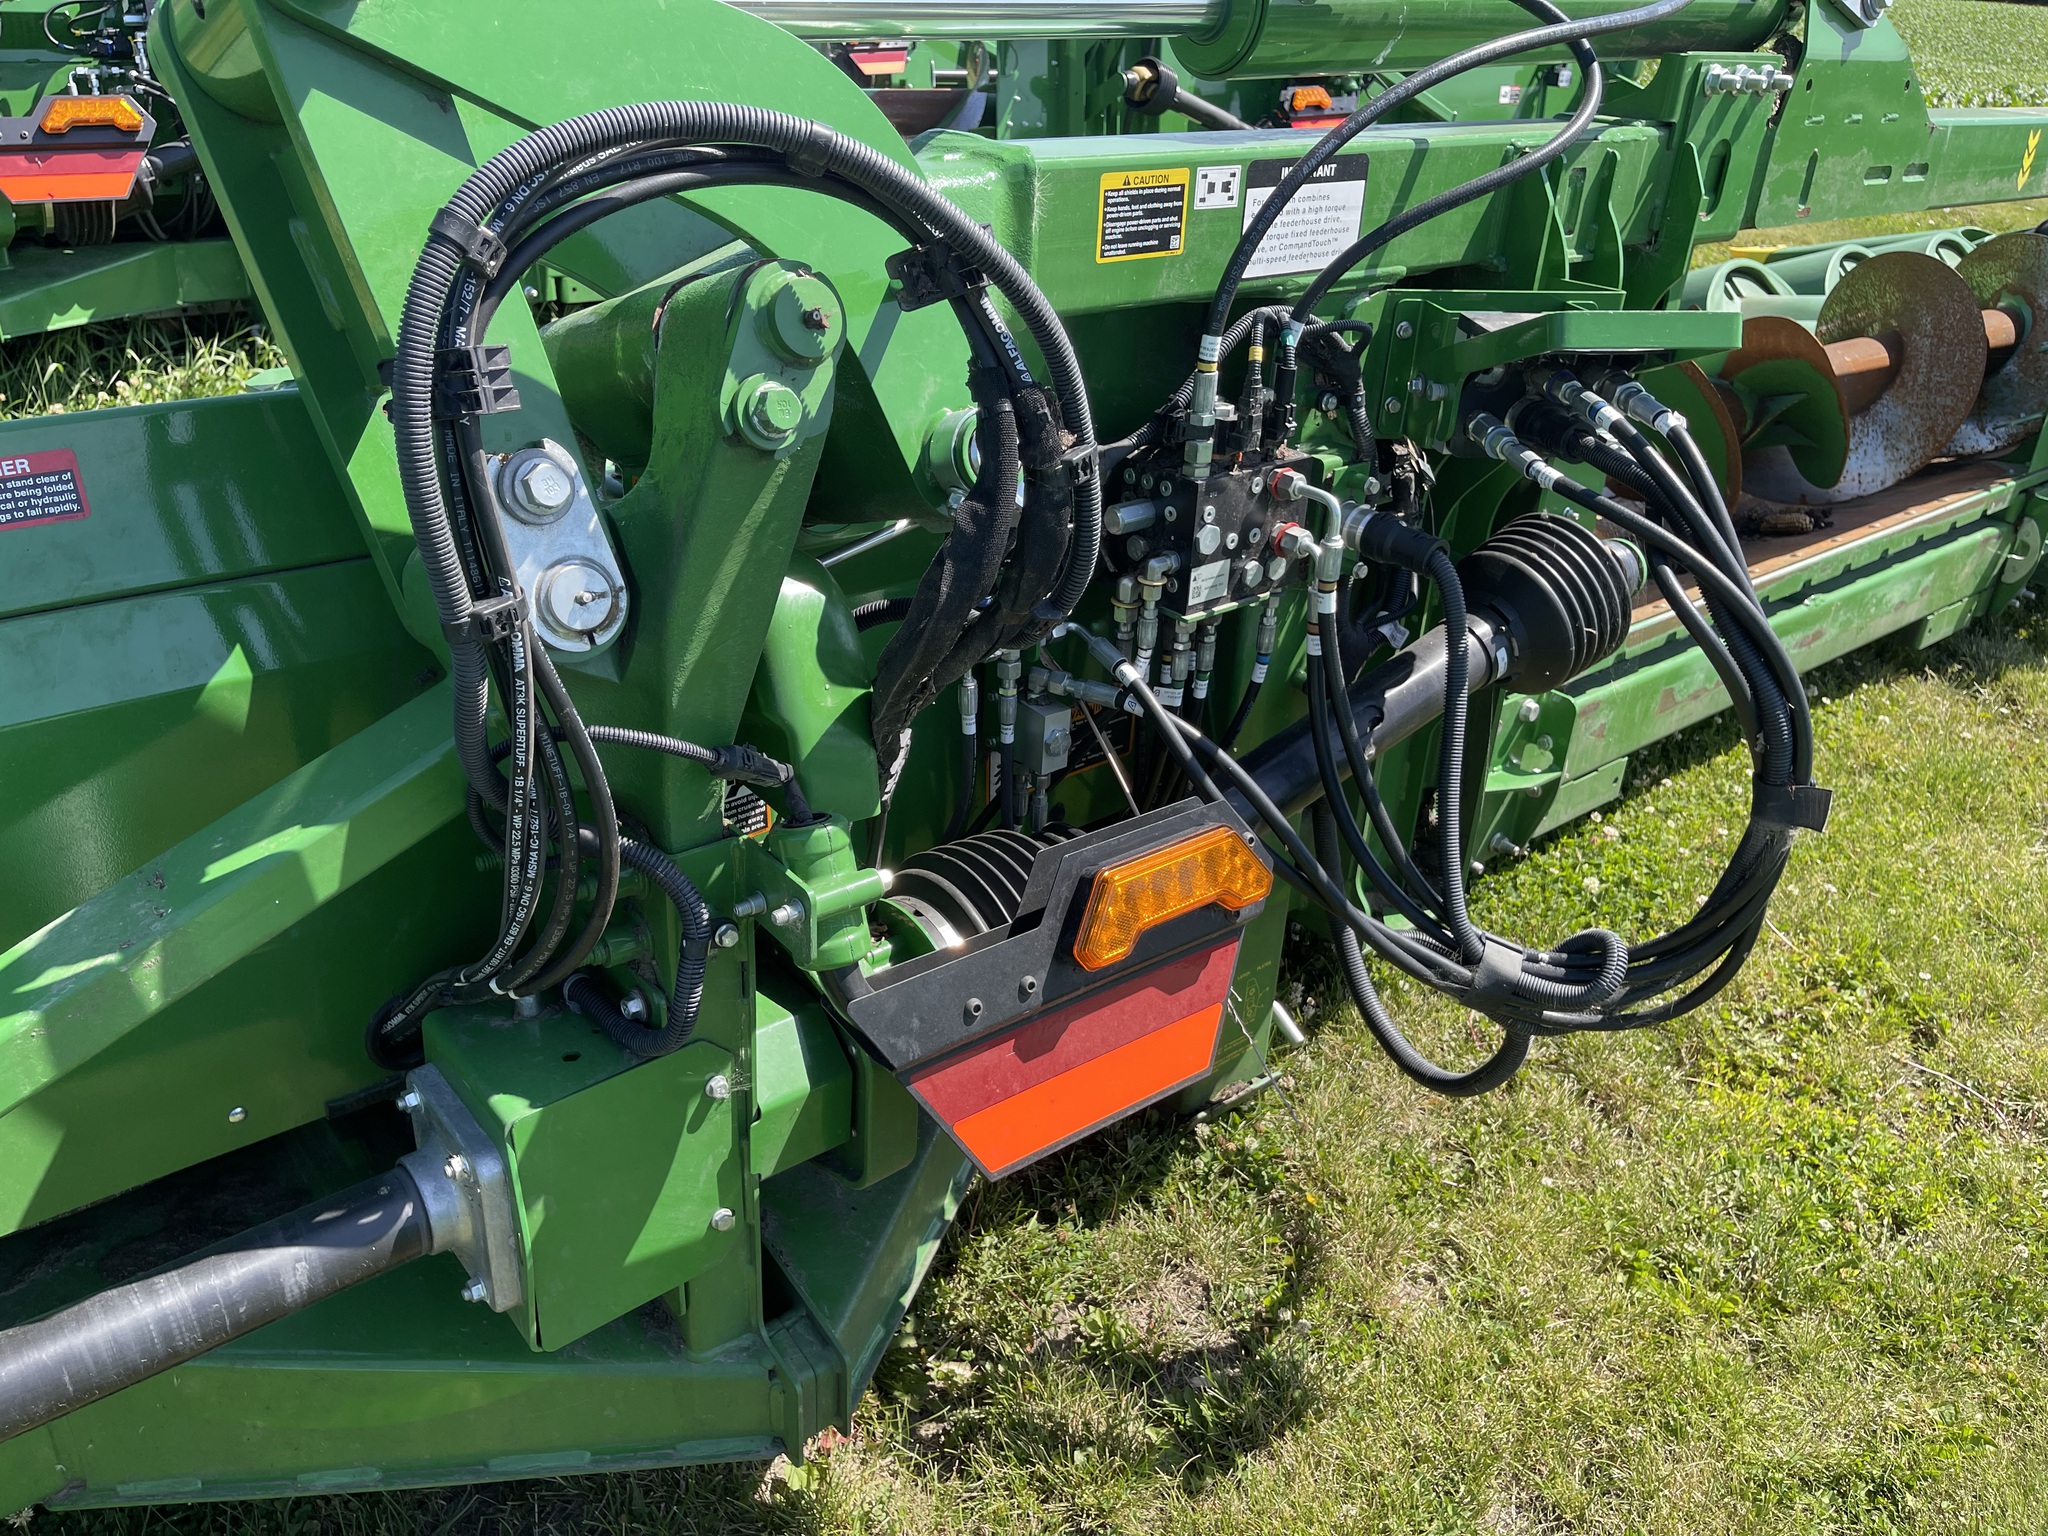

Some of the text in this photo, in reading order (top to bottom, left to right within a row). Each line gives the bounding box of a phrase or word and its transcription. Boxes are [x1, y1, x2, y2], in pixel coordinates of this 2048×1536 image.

[647, 155, 667, 167] 100
[584, 172, 600, 186] EN
[1133, 174, 1170, 186] CAUTION
[511, 185, 531, 205] DN
[1252, 198, 1265, 207] For
[1297, 193, 1331, 204] combines
[504, 202, 515, 213] 6
[1285, 206, 1301, 215] with
[1307, 205, 1324, 216] high
[1324, 203, 1347, 213] torque
[1279, 216, 1321, 228] feederhouse
[1266, 226, 1350, 242] torque fixed feederhouse
[1269, 244, 1277, 252] or
[1288, 249, 1330, 261] feederhouse
[444, 430, 458, 463] MADE
[6, 477, 34, 489] stand
[35, 475, 59, 484] clear
[61, 472, 72, 480] of
[450, 472, 461, 487] IN
[13, 488, 42, 496] being
[43, 482, 75, 494] folded
[0, 493, 77, 511] cal or hydraulic
[0, 502, 81, 523] gs to fall rapidly.
[454, 496, 470, 533] ITALY
[514, 678, 526, 705] AT3K
[515, 707, 526, 768] SUPERTUFF
[540, 731, 572, 816] MINETUFF-1B-04
[514, 775, 525, 787] 1B
[730, 797, 747, 808] avoid
[737, 810, 756, 820] hands
[755, 805, 766, 814] and
[747, 814, 764, 824] away
[512, 814, 523, 829] WP
[528, 808, 539, 849] IC-152/7
[511, 847, 521, 865] MPa
[526, 851, 539, 879] MSHA
[524, 885, 533, 893] 6
[520, 892, 532, 906] DN
[515, 906, 528, 922] 1SC
[509, 922, 520, 936] 857
[503, 935, 515, 946] EN
[494, 947, 507, 960] R17
